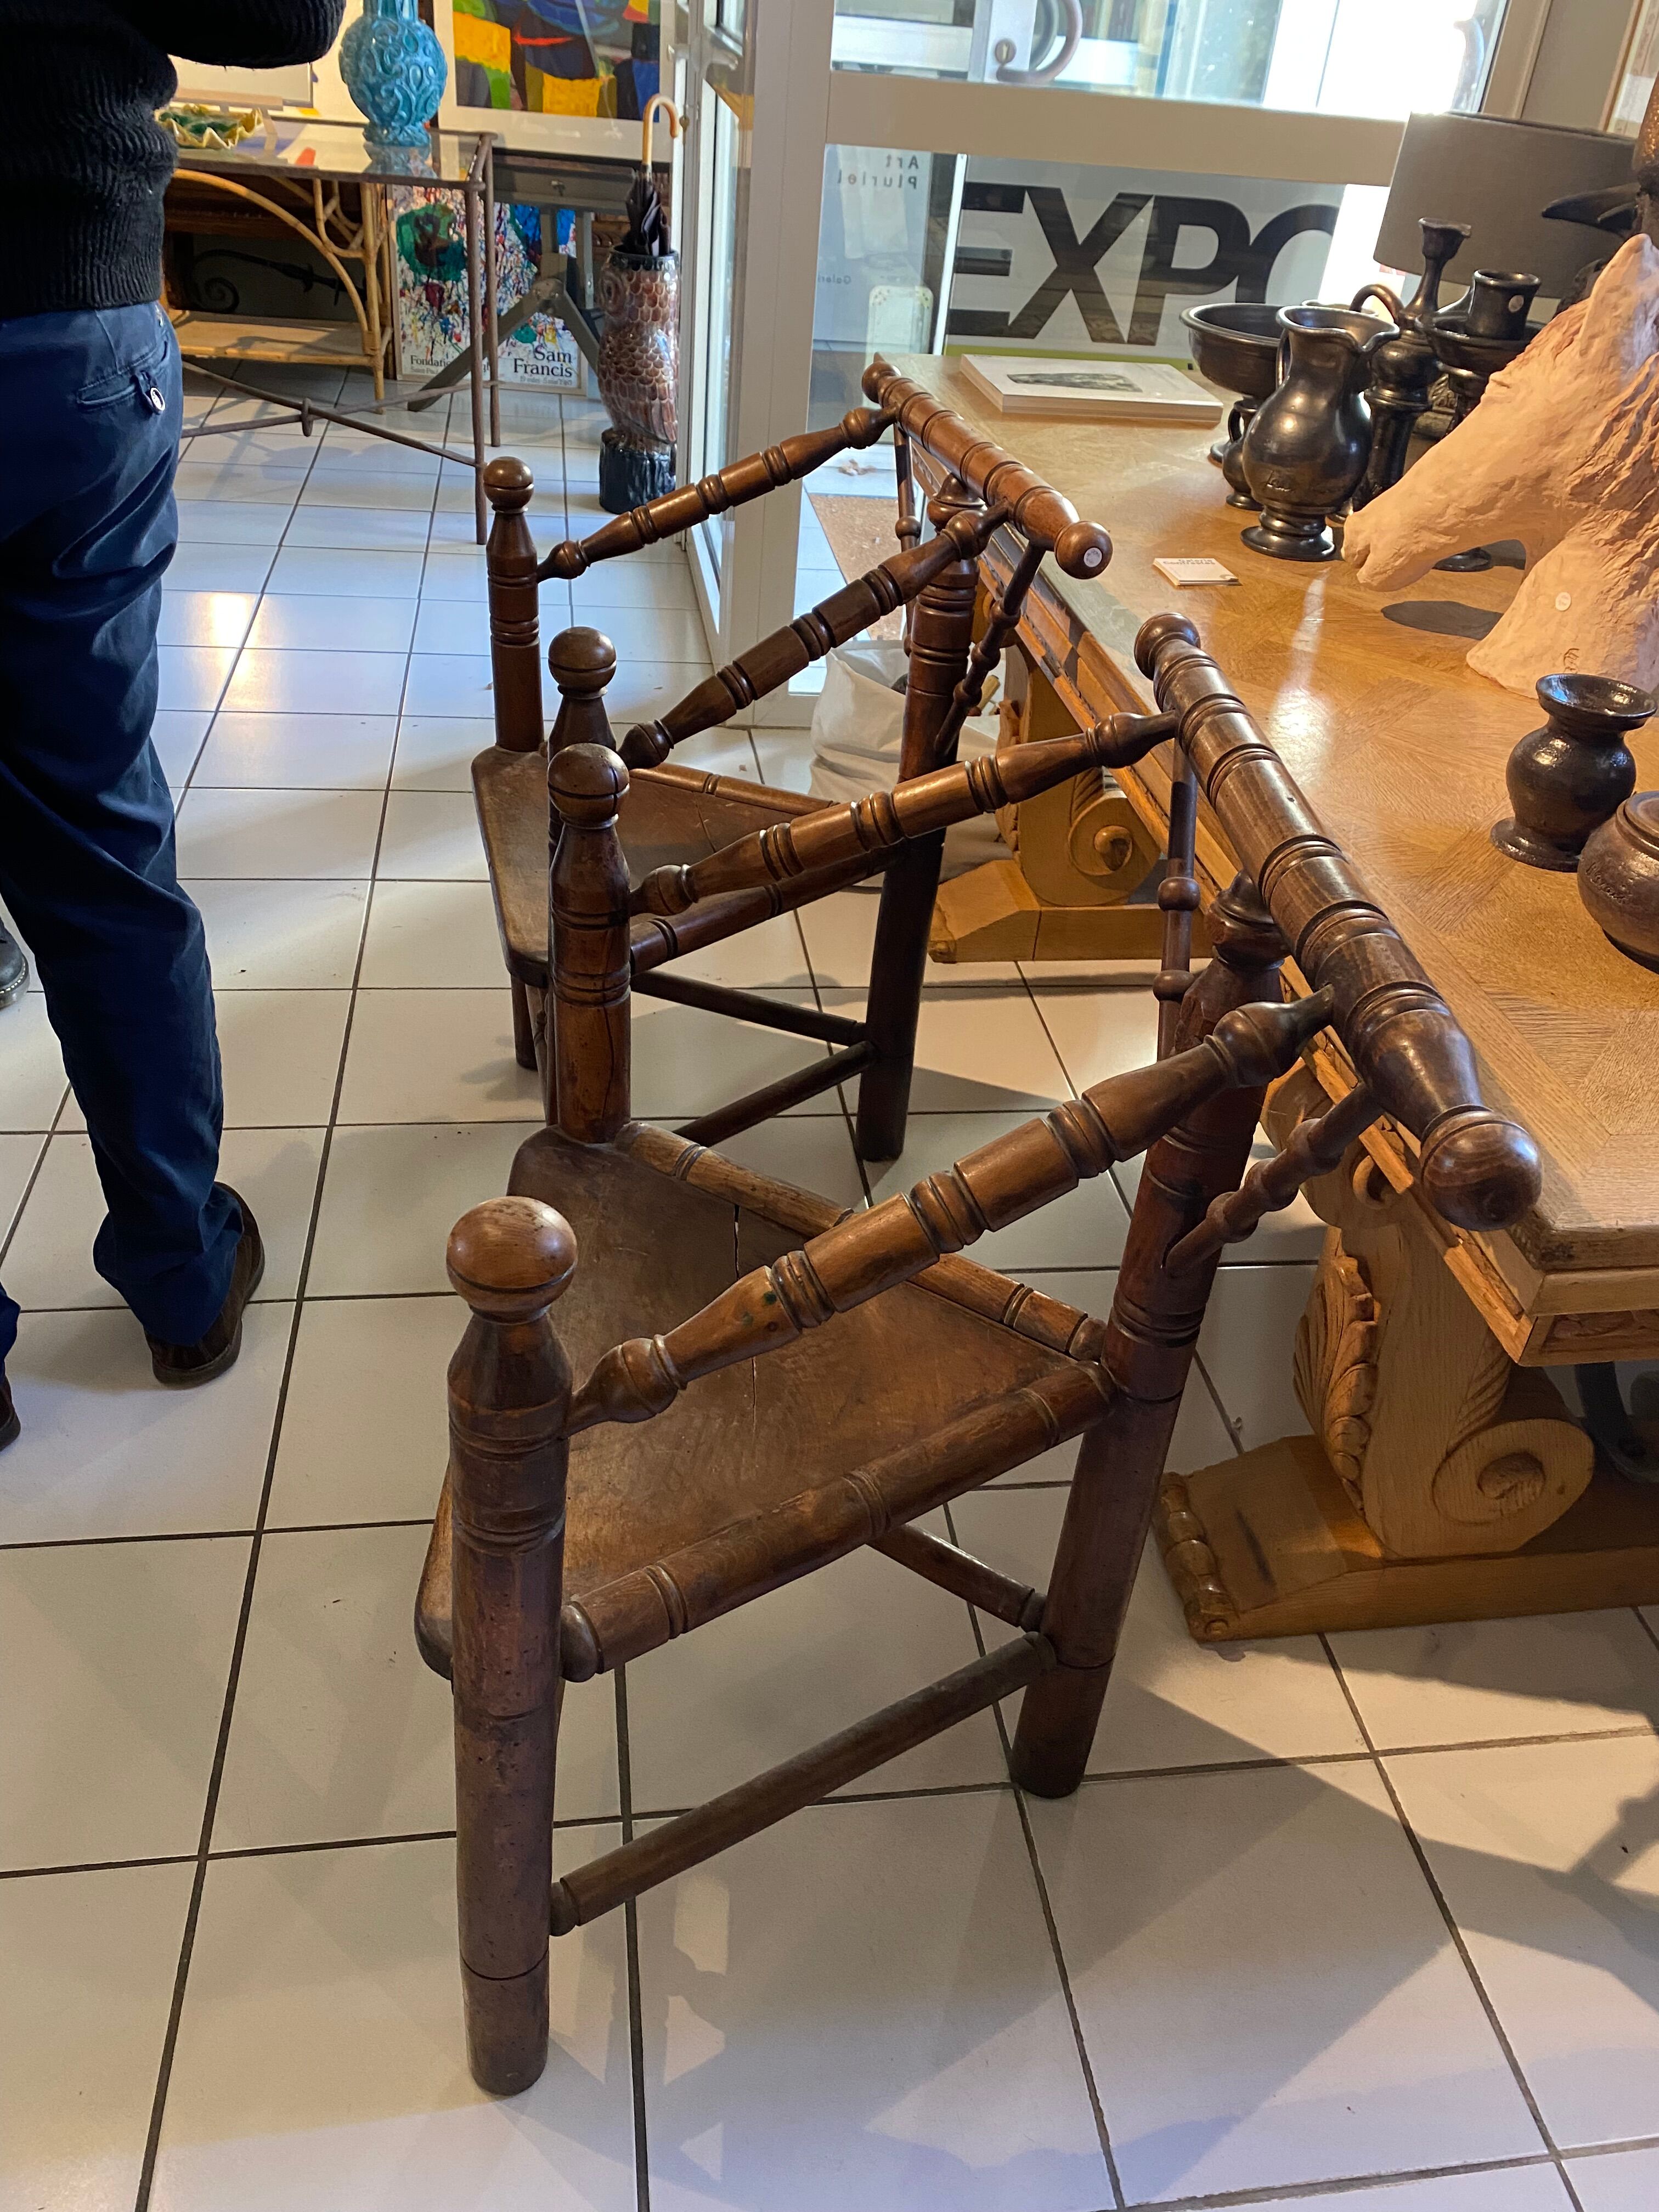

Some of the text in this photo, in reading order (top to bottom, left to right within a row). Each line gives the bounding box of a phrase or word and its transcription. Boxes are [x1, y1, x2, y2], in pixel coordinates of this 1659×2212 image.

[410, 354, 451, 367] Fondatio
[534, 343, 572, 363] Sam
[514, 358, 572, 377] Francis
